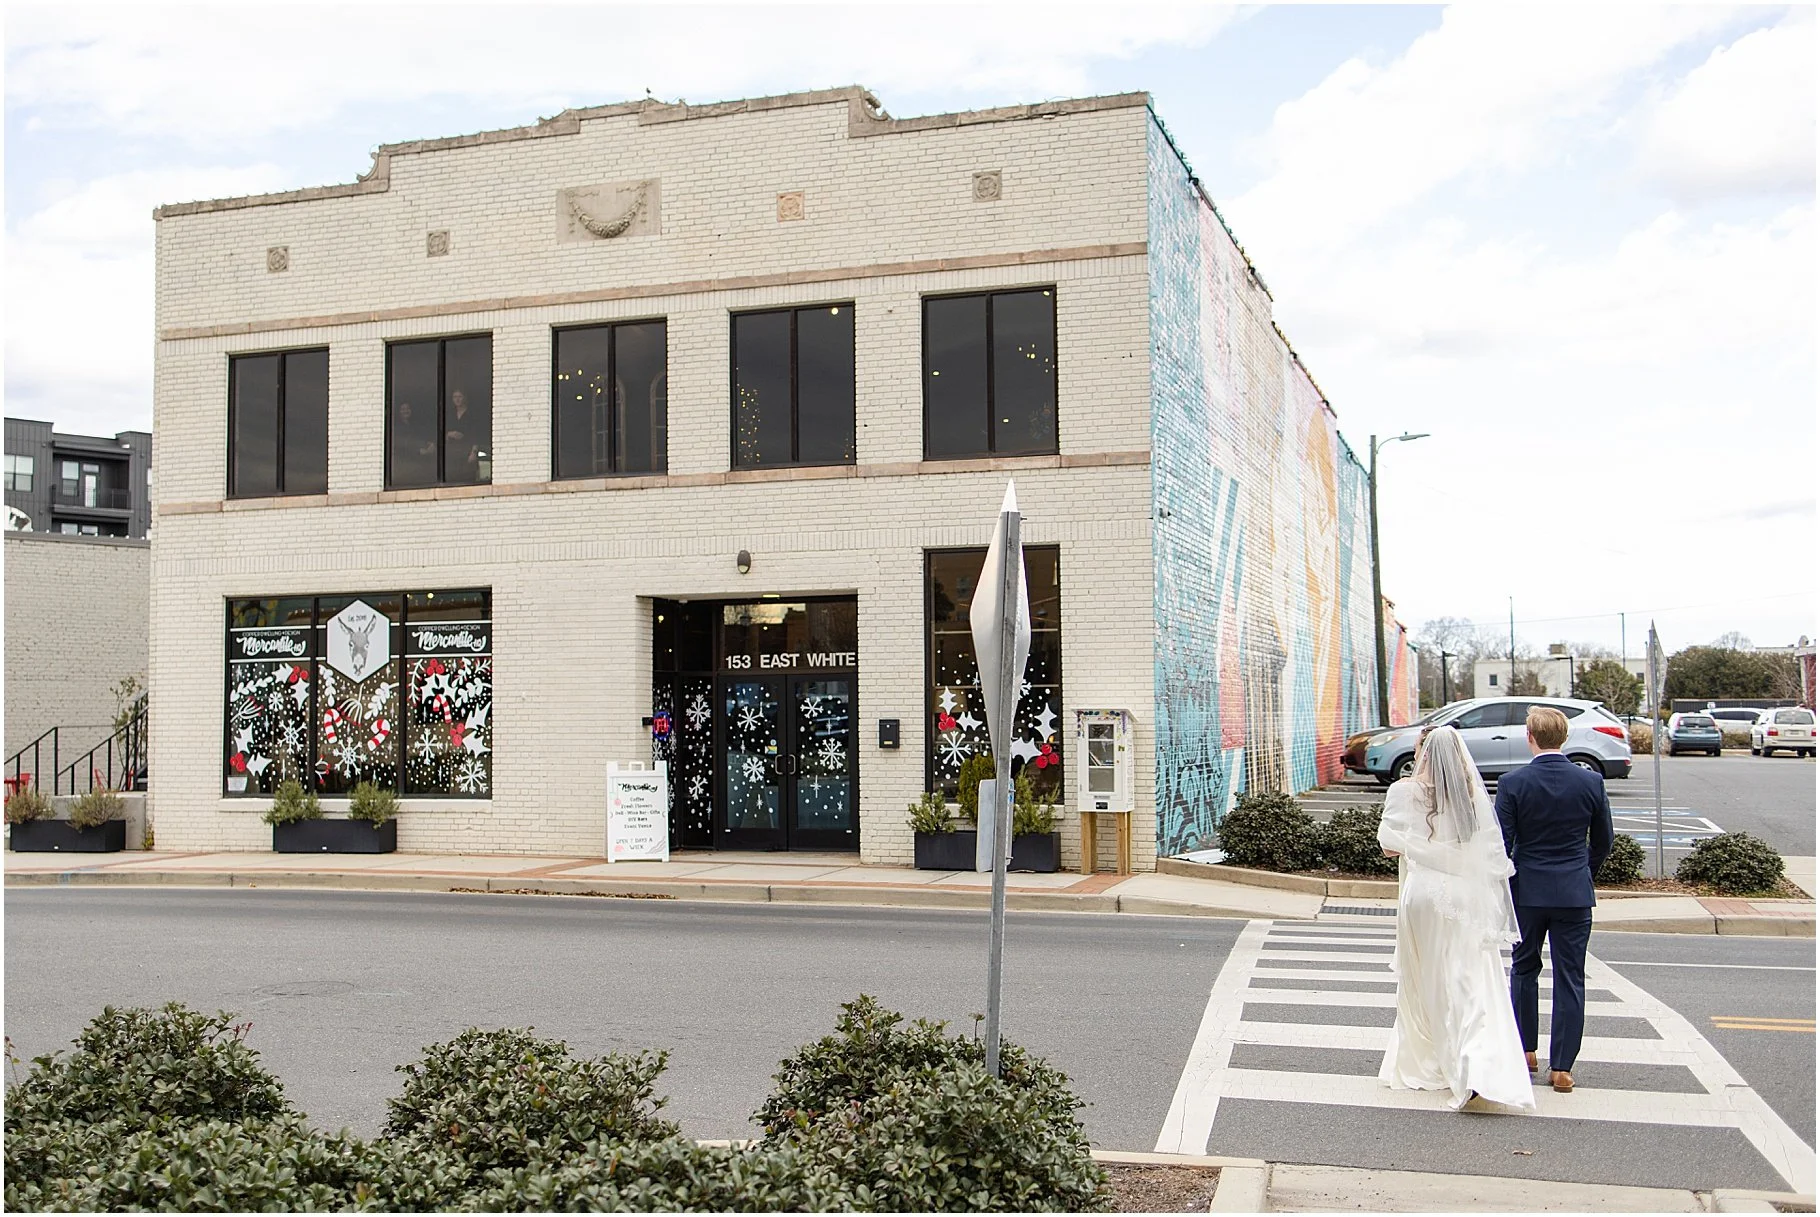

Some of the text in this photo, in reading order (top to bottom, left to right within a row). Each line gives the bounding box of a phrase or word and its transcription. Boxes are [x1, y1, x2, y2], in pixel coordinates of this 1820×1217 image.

[236, 635, 306, 656] Mercantile
[412, 630, 486, 652] Mercantile
[725, 652, 856, 669] 153 EAST WHITE
